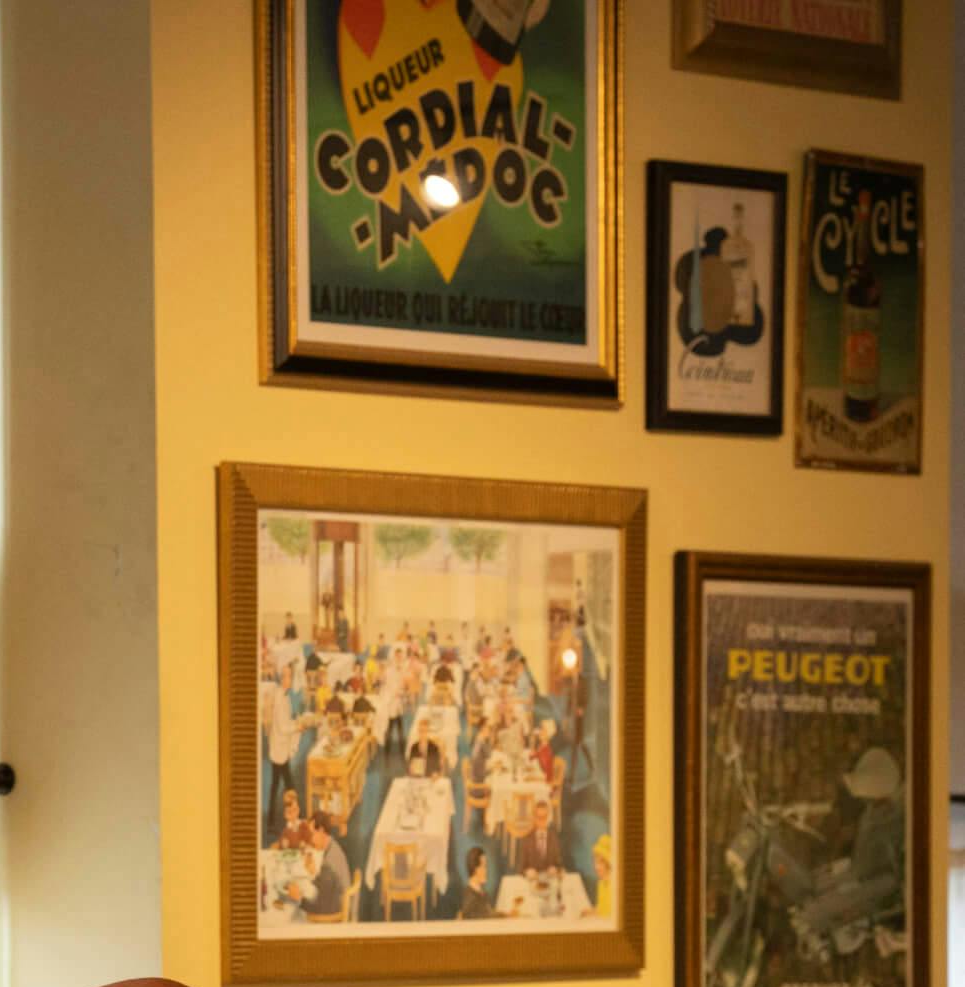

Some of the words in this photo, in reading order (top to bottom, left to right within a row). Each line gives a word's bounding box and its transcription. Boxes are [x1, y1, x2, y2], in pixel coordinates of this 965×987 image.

[352, 38, 445, 115] LIQUEUR
[829, 171, 852, 205] LE
[311, 283, 331, 314] LA
[336, 285, 406, 318] LIQUEUR
[413, 290, 441, 325] QUI
[727, 648, 891, 687] PEUGEOT
